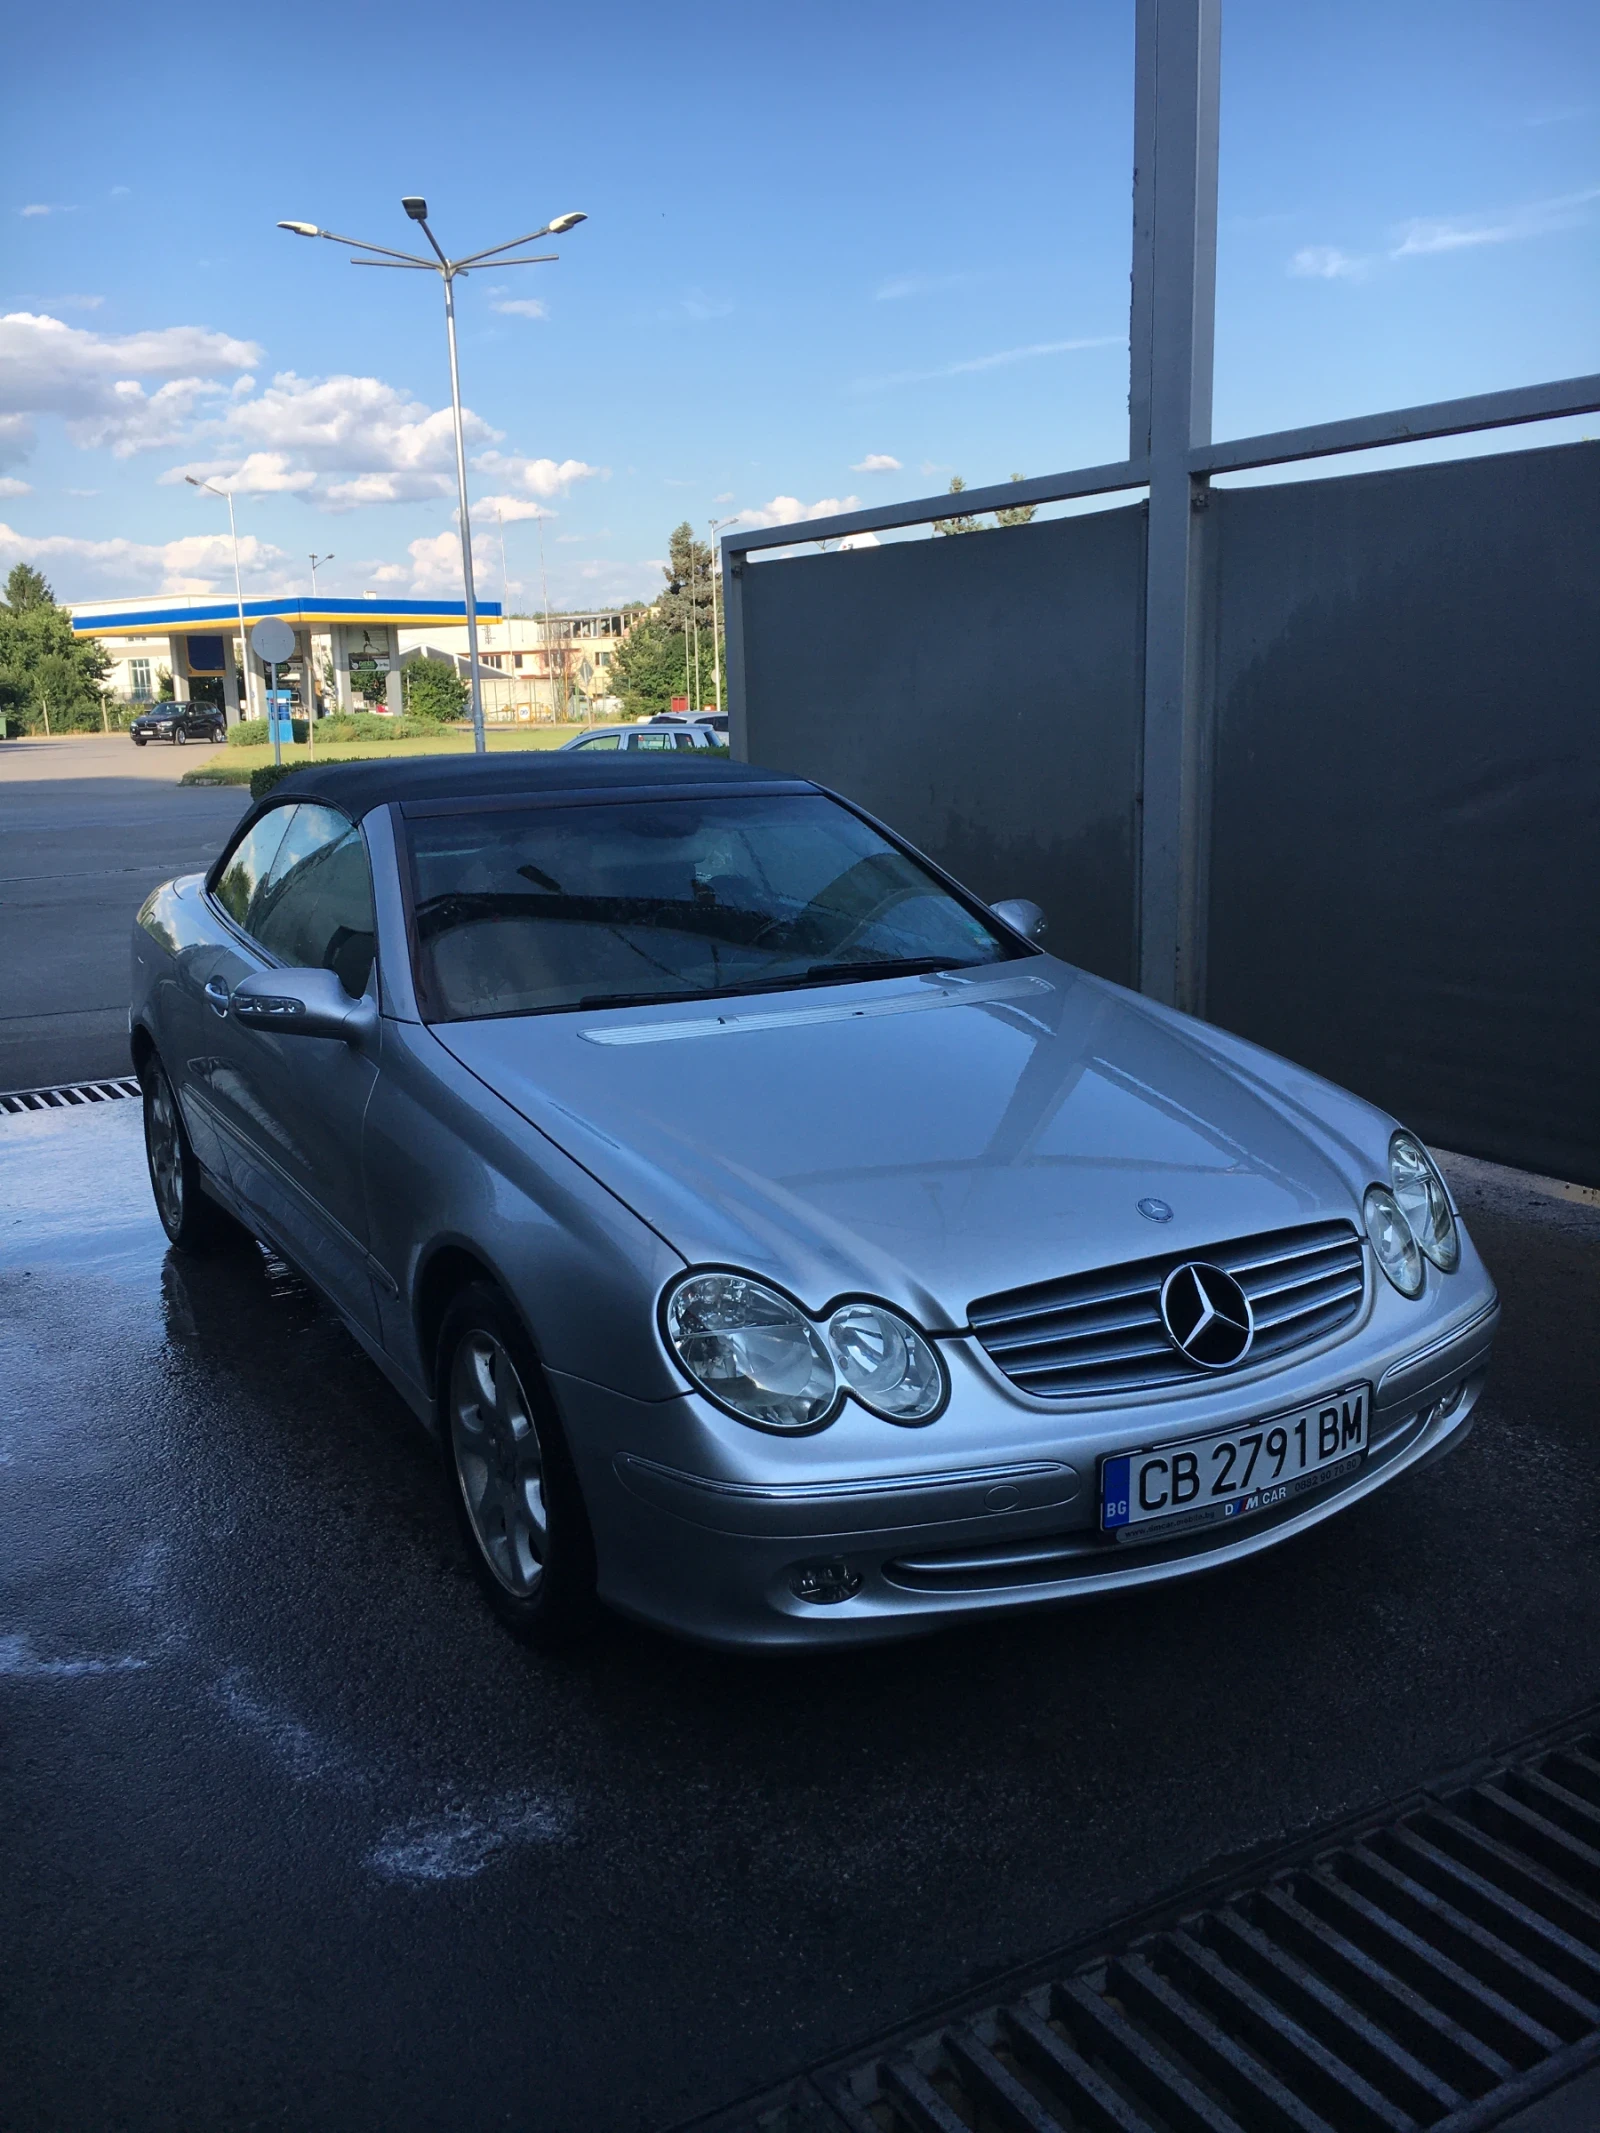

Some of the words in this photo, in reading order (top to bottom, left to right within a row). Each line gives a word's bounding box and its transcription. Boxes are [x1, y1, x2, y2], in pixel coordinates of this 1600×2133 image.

[1139, 1450, 1200, 1511] CB
[1211, 1417, 1307, 1496] 2791
[1318, 1395, 1363, 1460] BM
[1294, 1476, 1318, 1492] 0882
[1320, 1470, 1331, 1482] 90
[1334, 1464, 1344, 1476] 70
[1346, 1459, 1357, 1470] 80
[1261, 1486, 1287, 1504] CAR
[1106, 1499, 1127, 1518] BG
